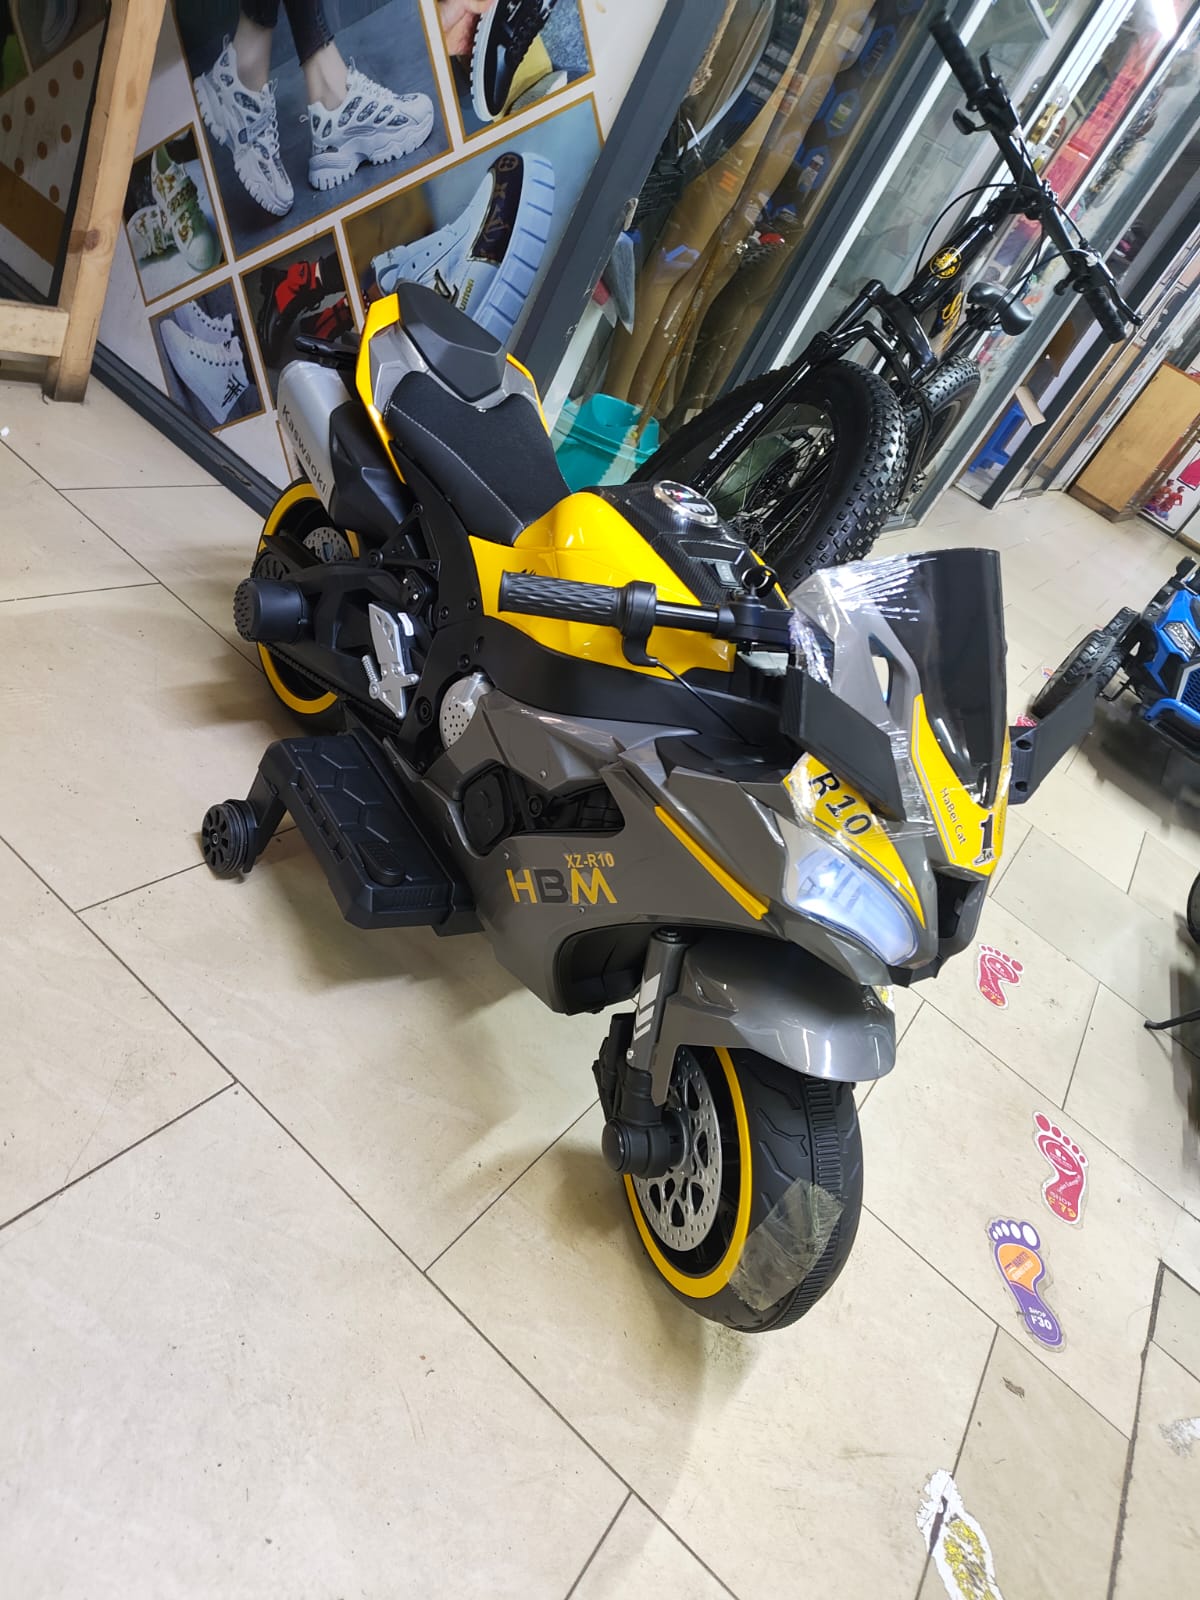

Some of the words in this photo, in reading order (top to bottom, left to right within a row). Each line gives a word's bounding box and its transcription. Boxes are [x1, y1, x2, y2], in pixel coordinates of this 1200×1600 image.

[283, 403, 328, 493] Kaswaoki
[955, 825, 966, 845] Cat
[564, 852, 615, 868] XZ-R10
[505, 867, 618, 905] HBM
[1030, 1314, 1052, 1330] F30
